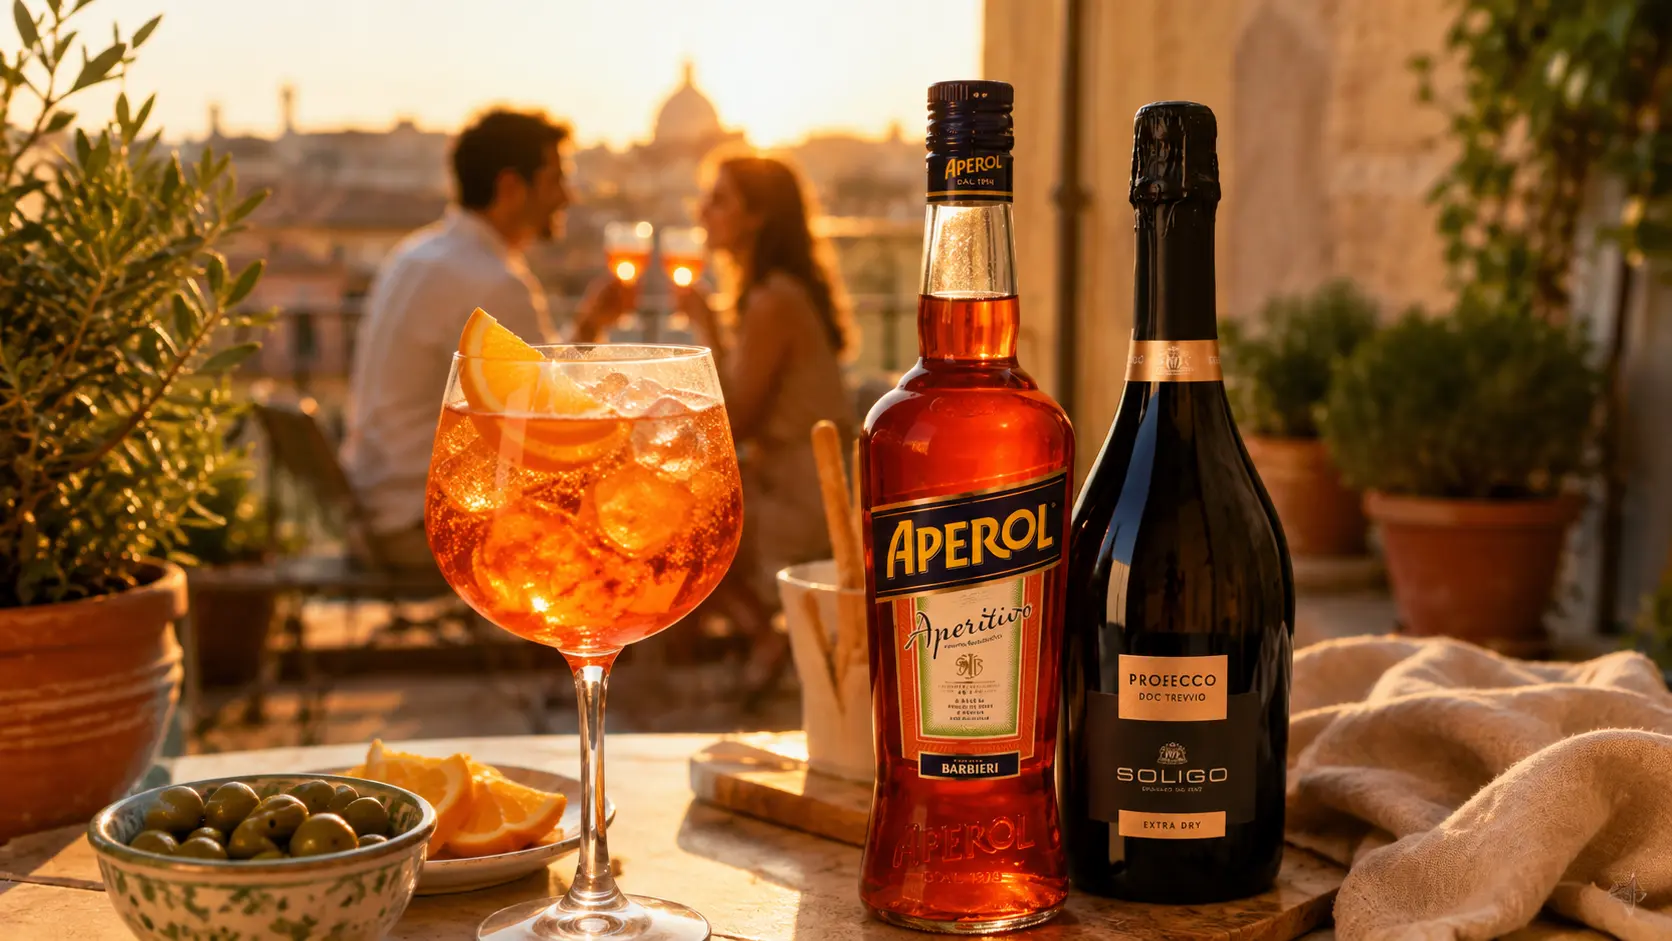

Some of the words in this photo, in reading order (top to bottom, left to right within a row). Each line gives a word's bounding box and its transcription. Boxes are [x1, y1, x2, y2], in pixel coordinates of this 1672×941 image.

[945, 155, 1002, 180] APEROL
[886, 503, 1054, 580] APEROL
[904, 603, 1033, 660] Aperitivo
[1138, 693, 1162, 702] DOC
[941, 762, 999, 775] BARBIERI
[1116, 767, 1228, 784] SOLIGO
[1143, 820, 1176, 830] EXTRA
[1180, 821, 1202, 830] DRY
[892, 814, 1036, 869] APEROL
